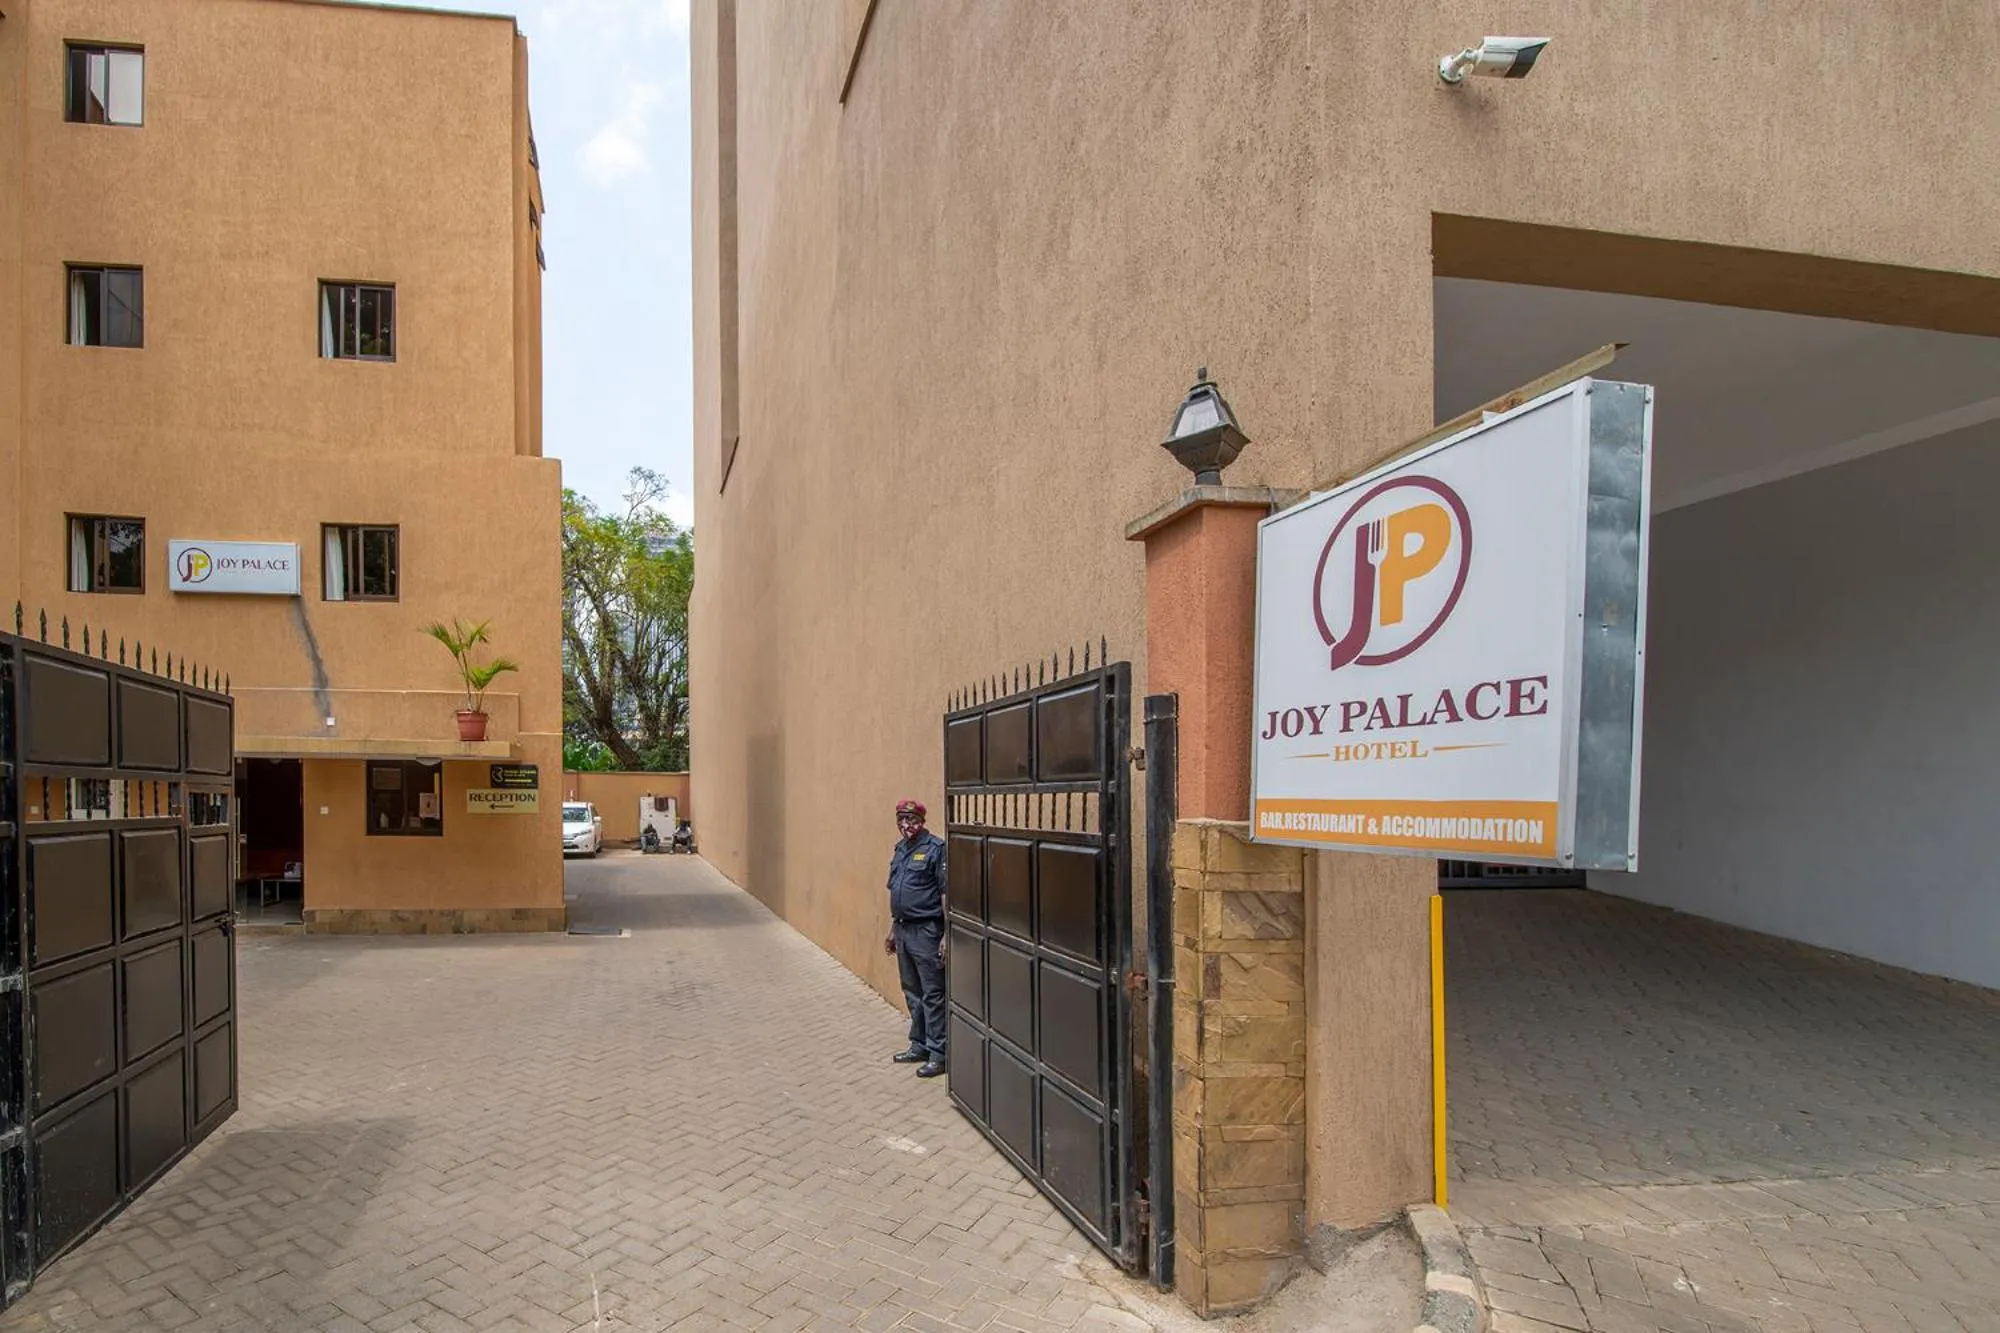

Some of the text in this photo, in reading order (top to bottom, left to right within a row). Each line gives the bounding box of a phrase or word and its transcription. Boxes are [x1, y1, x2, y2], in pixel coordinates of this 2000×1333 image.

[217, 558, 290, 571] JOY PALACE
[1262, 675, 1549, 740] JOY PALACE
[1332, 740, 1429, 762] HOTEL
[469, 792, 536, 802] RECEPTION
[1367, 817, 1379, 835] &
[1382, 815, 1544, 845] ACCOMMODATION
